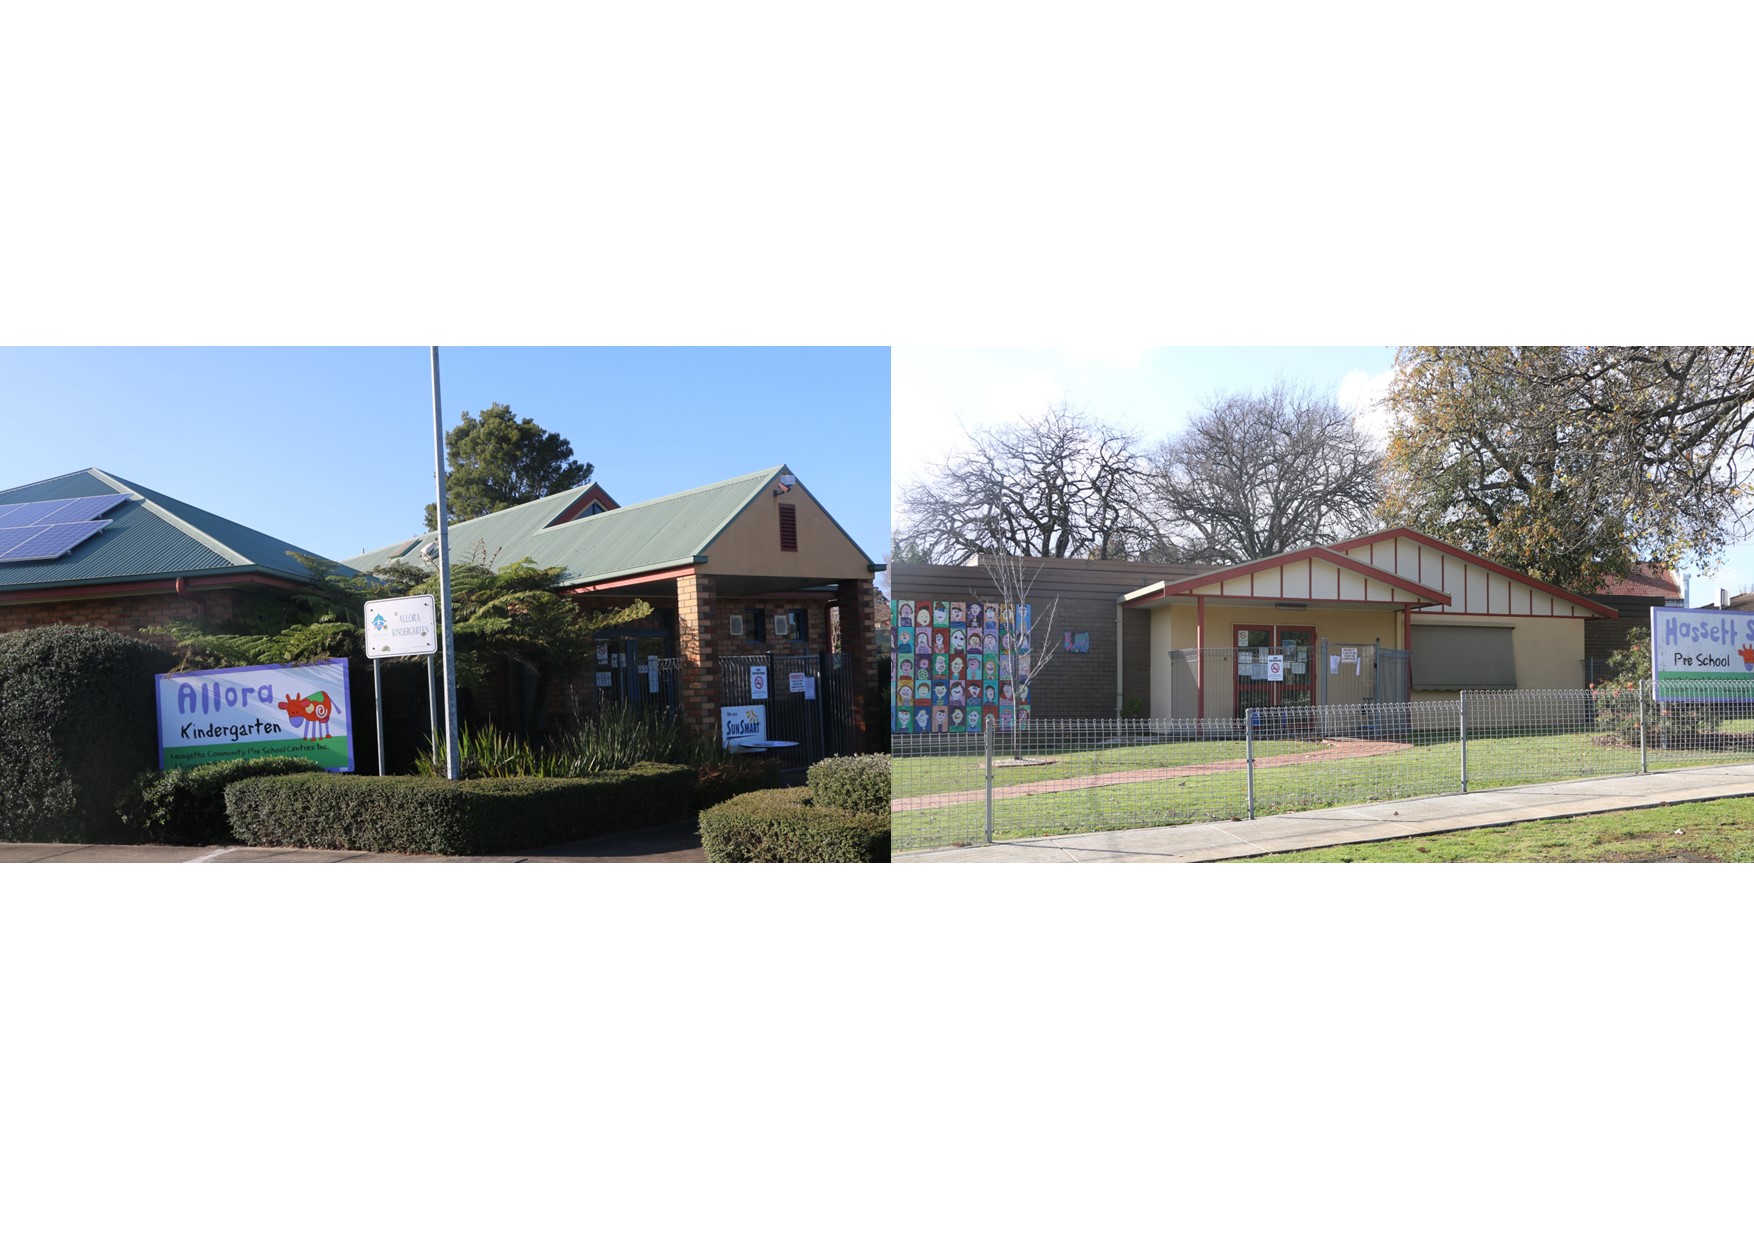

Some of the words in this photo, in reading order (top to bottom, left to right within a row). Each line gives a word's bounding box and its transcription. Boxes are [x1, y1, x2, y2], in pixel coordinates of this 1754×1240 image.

[399, 613, 421, 623] ALLORA
[1665, 617, 1738, 646] Hassett
[1674, 652, 1693, 667] Pre
[1696, 653, 1731, 667] School
[177, 682, 274, 715] Allora
[180, 718, 282, 742] Kindergarten
[206, 748, 246, 758] Community
[247, 747, 260, 755] Pre
[262, 745, 286, 754] School
[286, 744, 315, 753] Centres
